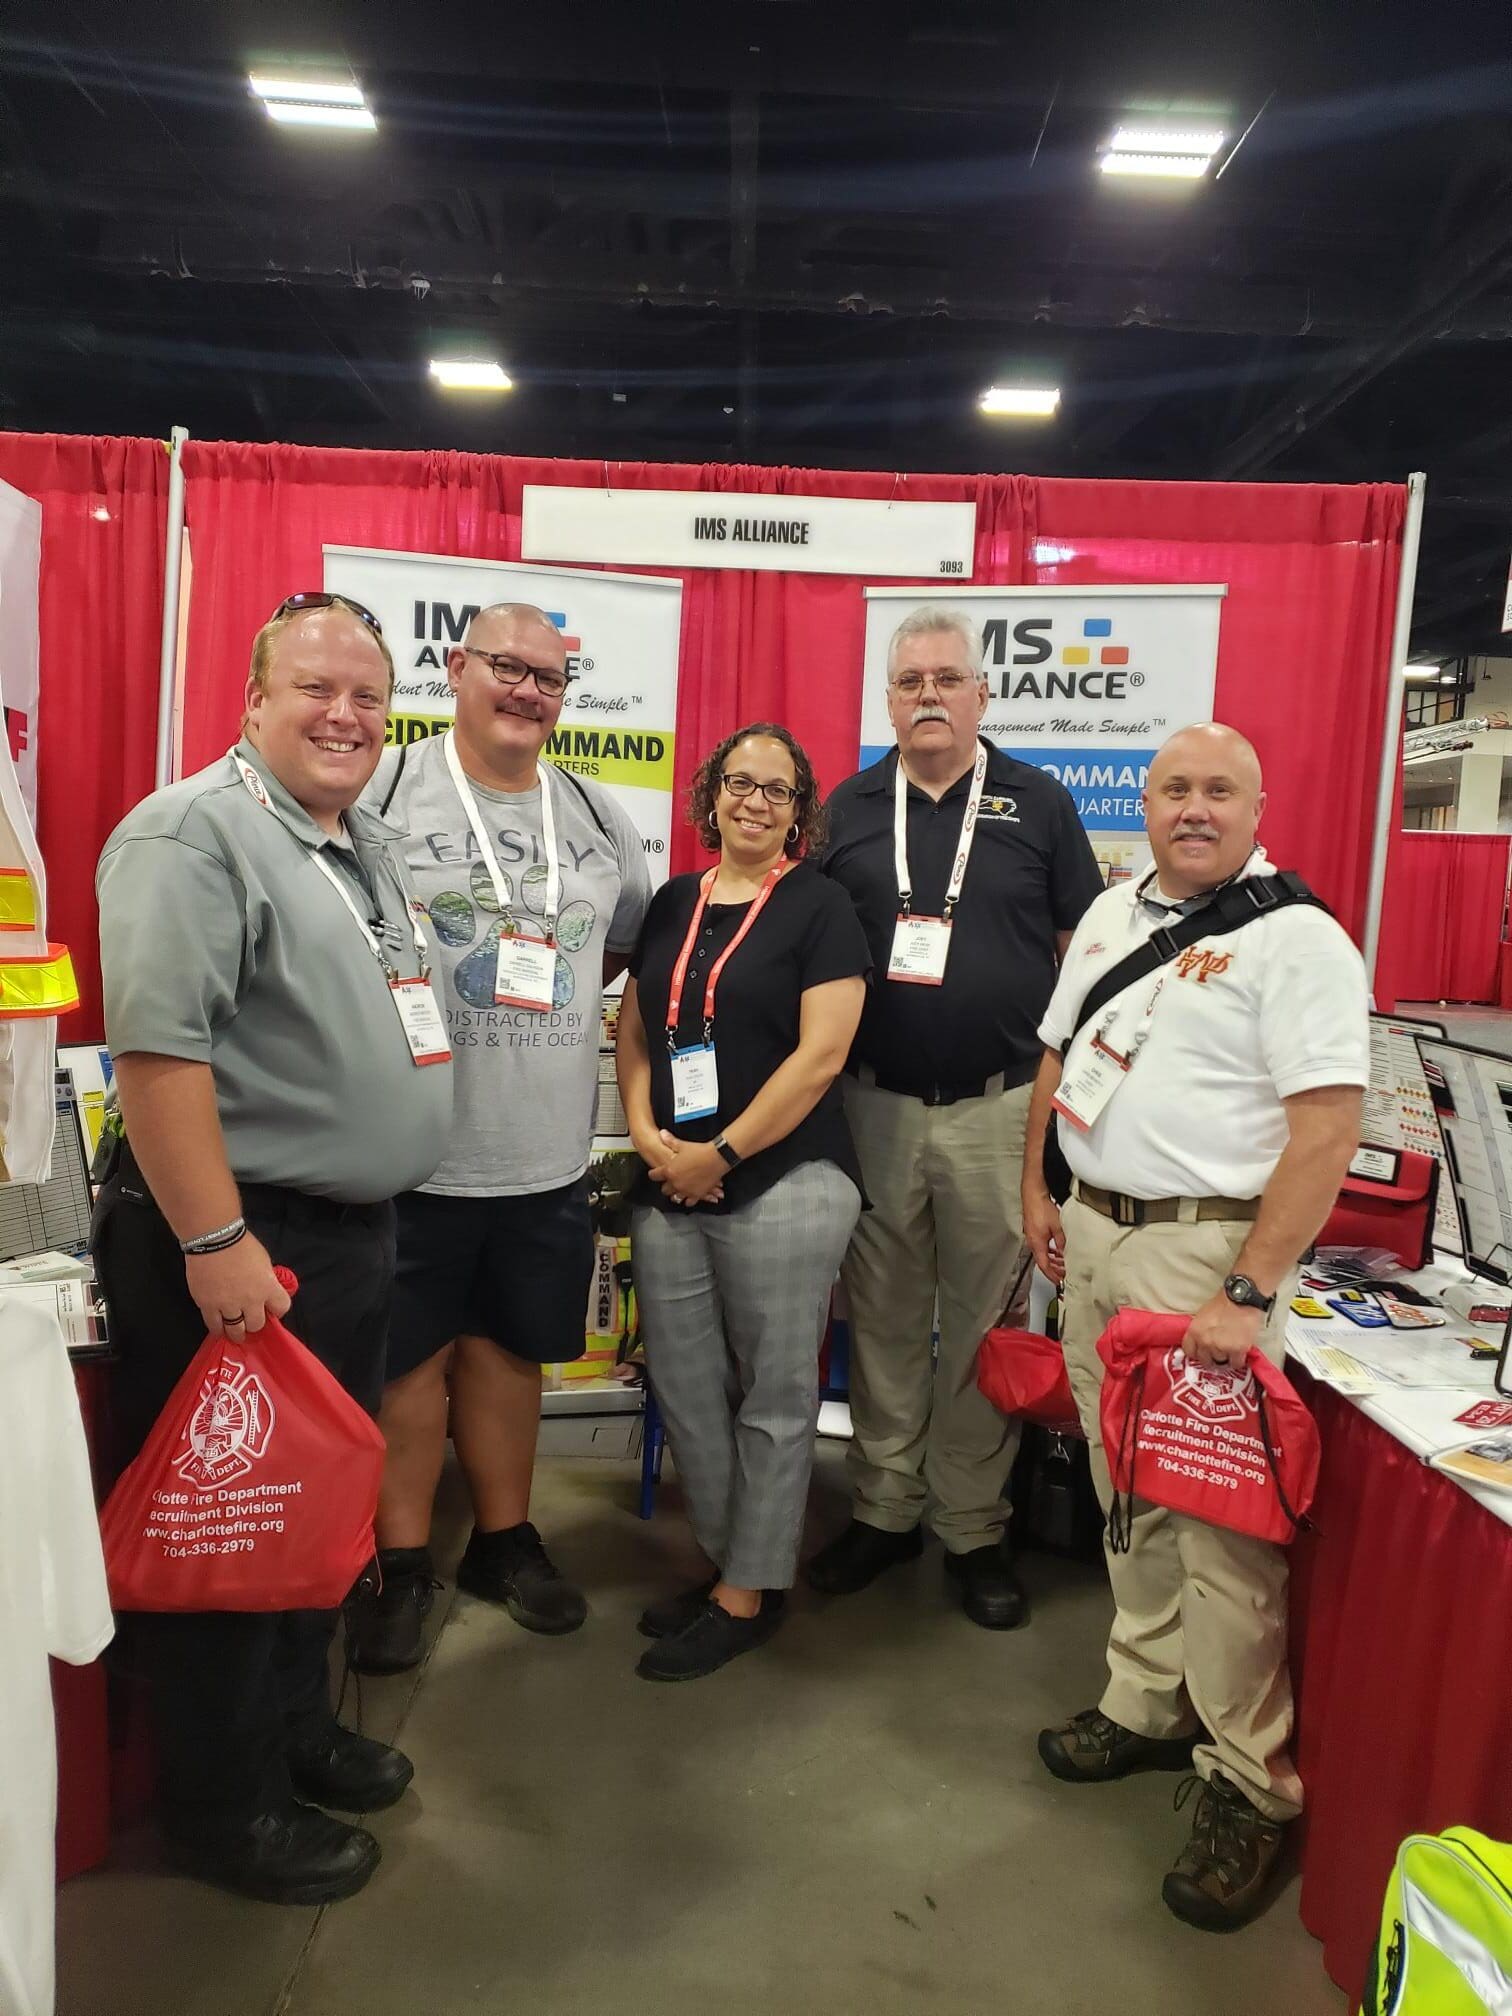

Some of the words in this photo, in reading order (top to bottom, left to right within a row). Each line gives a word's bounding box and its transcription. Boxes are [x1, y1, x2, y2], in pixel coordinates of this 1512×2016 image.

[694, 517, 727, 541] IMS
[732, 518, 810, 545] ALLIANCE
[940, 560, 963, 574] 3093
[414, 600, 481, 643] IM
[982, 618, 1053, 665] MS
[984, 671, 1145, 700] LIANCE®
[1050, 718, 1095, 734] Made
[545, 730, 665, 762] MMAND
[424, 829, 596, 872] EASIY
[567, 1012, 583, 1027] BY
[449, 1031, 478, 1047] GS
[485, 1032, 500, 1047] &
[507, 1032, 542, 1047] THE
[599, 1253, 610, 1328] COMMAND
[1186, 1418, 1210, 1433] Fire
[1212, 1425, 1282, 1457] Departmnt
[1216, 1442, 1266, 1467] Division
[1157, 1457, 1238, 1489] 704-336-2979
[217, 1481, 302, 1502] Department
[225, 1501, 284, 1518] Division
[163, 1538, 255, 1558] 704-336-2979
